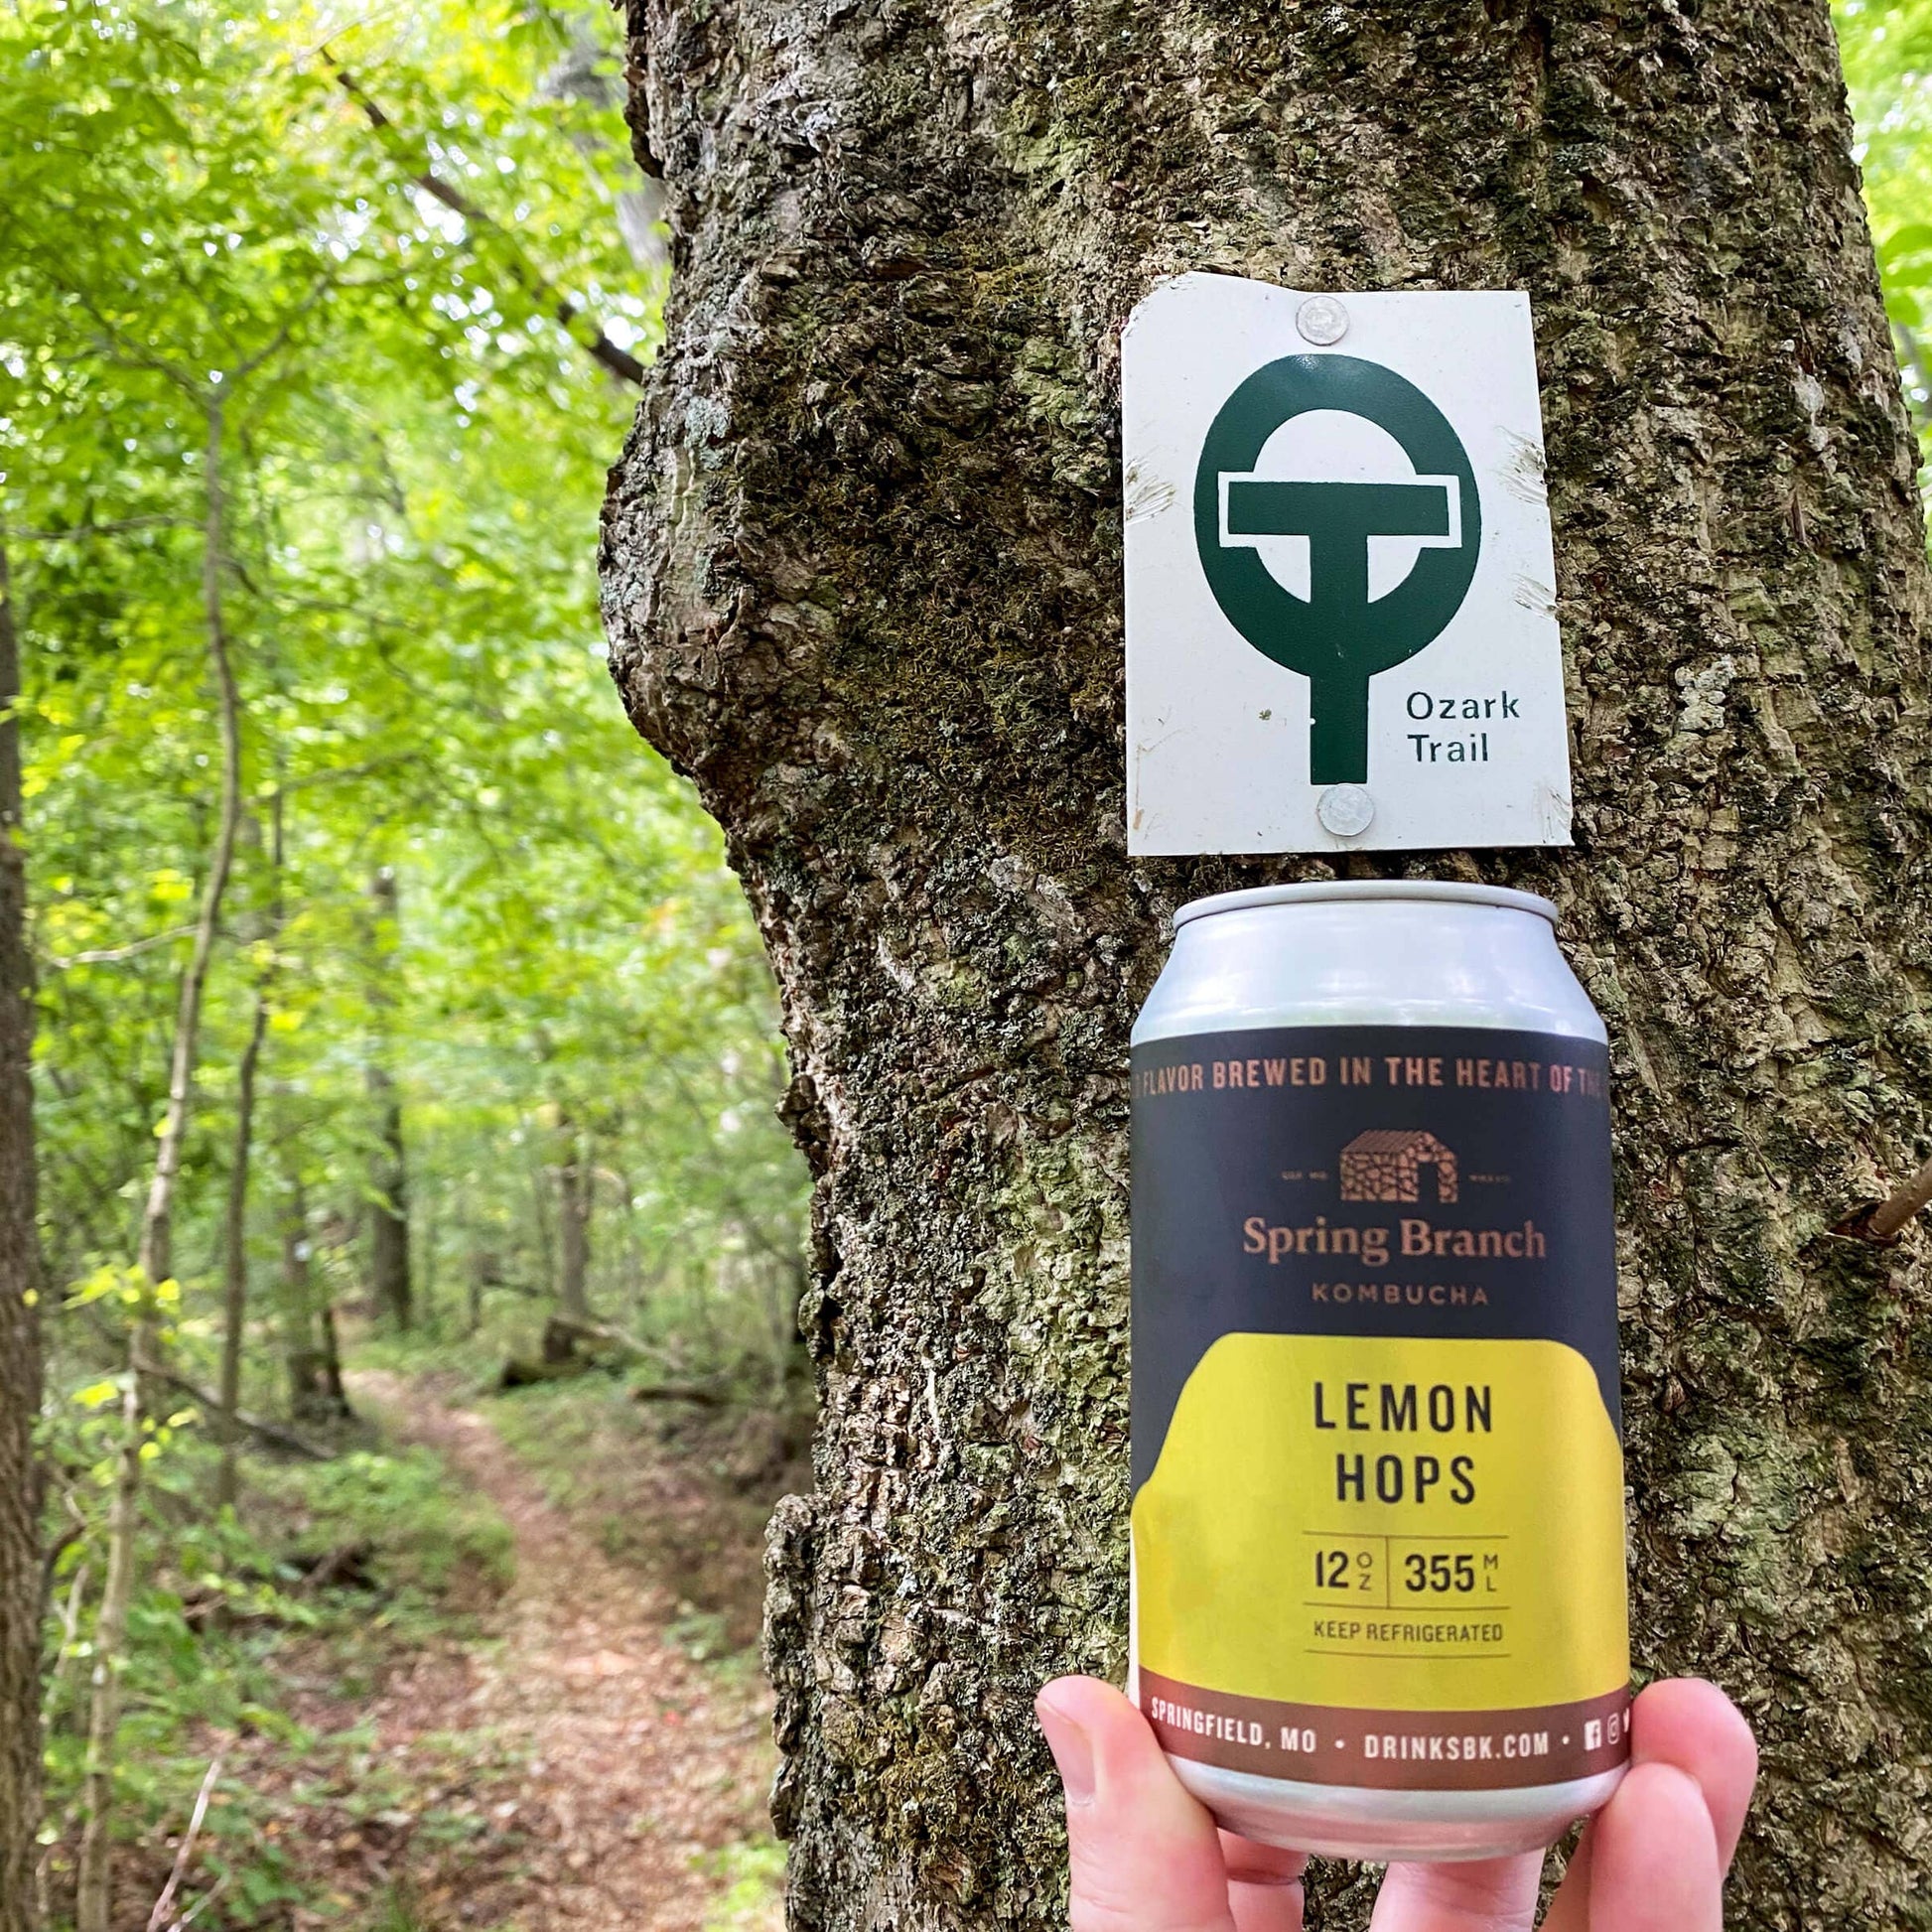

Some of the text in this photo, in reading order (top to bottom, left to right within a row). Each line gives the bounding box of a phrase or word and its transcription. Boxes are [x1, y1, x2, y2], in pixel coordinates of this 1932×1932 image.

[1406, 691, 1520, 721] Ozark
[1407, 733, 1489, 762] Trail
[1143, 1063, 1203, 1097] FLAVOR
[1212, 1056, 1325, 1090] BREWED
[1339, 1056, 1371, 1085] IN
[1385, 1055, 1444, 1086] THE
[1455, 1058, 1539, 1091] HEART
[1549, 1064, 1573, 1093] OF
[1242, 1215, 1547, 1267] Spring Branch
[1311, 1284, 1490, 1306] KOMBUCHA
[1313, 1381, 1492, 1434] LEMON
[1335, 1452, 1476, 1505] HOPS
[1314, 1550, 1349, 1588] 12
[1404, 1553, 1475, 1592] 355
[1313, 1620, 1503, 1643] KEEP REFRIGERATED
[1151, 1696, 1550, 1761] SPRINGFIELD, MO DRINKSBK.COM
